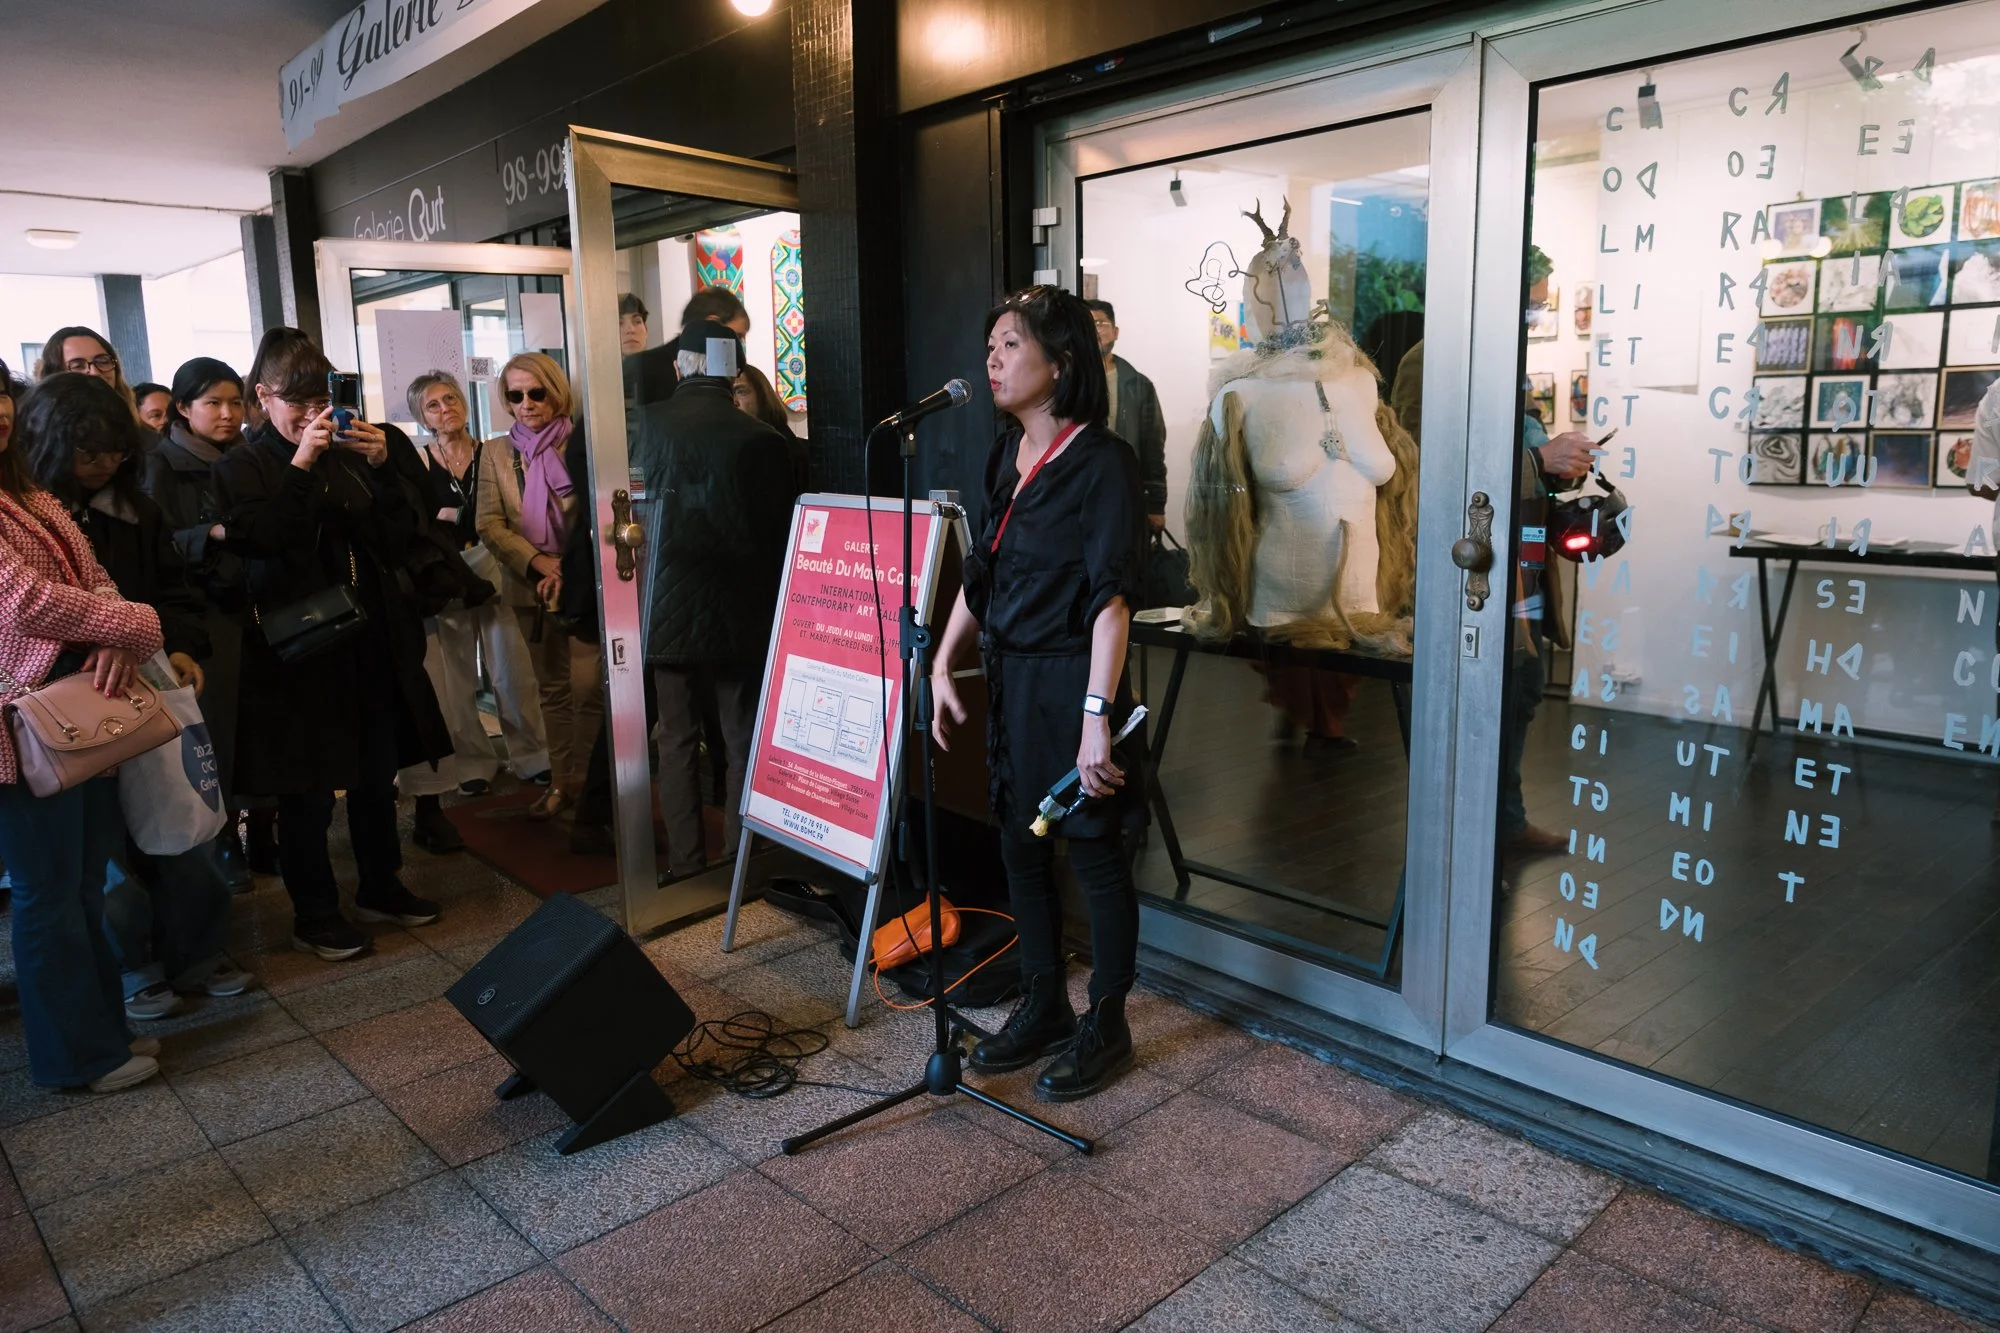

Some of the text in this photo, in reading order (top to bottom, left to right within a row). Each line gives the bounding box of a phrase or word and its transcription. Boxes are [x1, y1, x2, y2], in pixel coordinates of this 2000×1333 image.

[503, 143, 565, 205] 98-99
[844, 541, 879, 554] GALERE
[796, 554, 833, 574] Beauté
[835, 560, 851, 577] Du
[791, 593, 854, 612] CONTEMPORARY
[856, 605, 874, 617] ART
[793, 618, 815, 629] OUVERT
[816, 623, 825, 632] DU
[826, 626, 842, 636] JEUDI
[844, 629, 853, 638] AU
[854, 632, 873, 642] LUNDI
[800, 630, 807, 638] ET
[832, 637, 860, 650] MECREDI
[861, 644, 873, 653] SUR
[875, 647, 889, 656] RV
